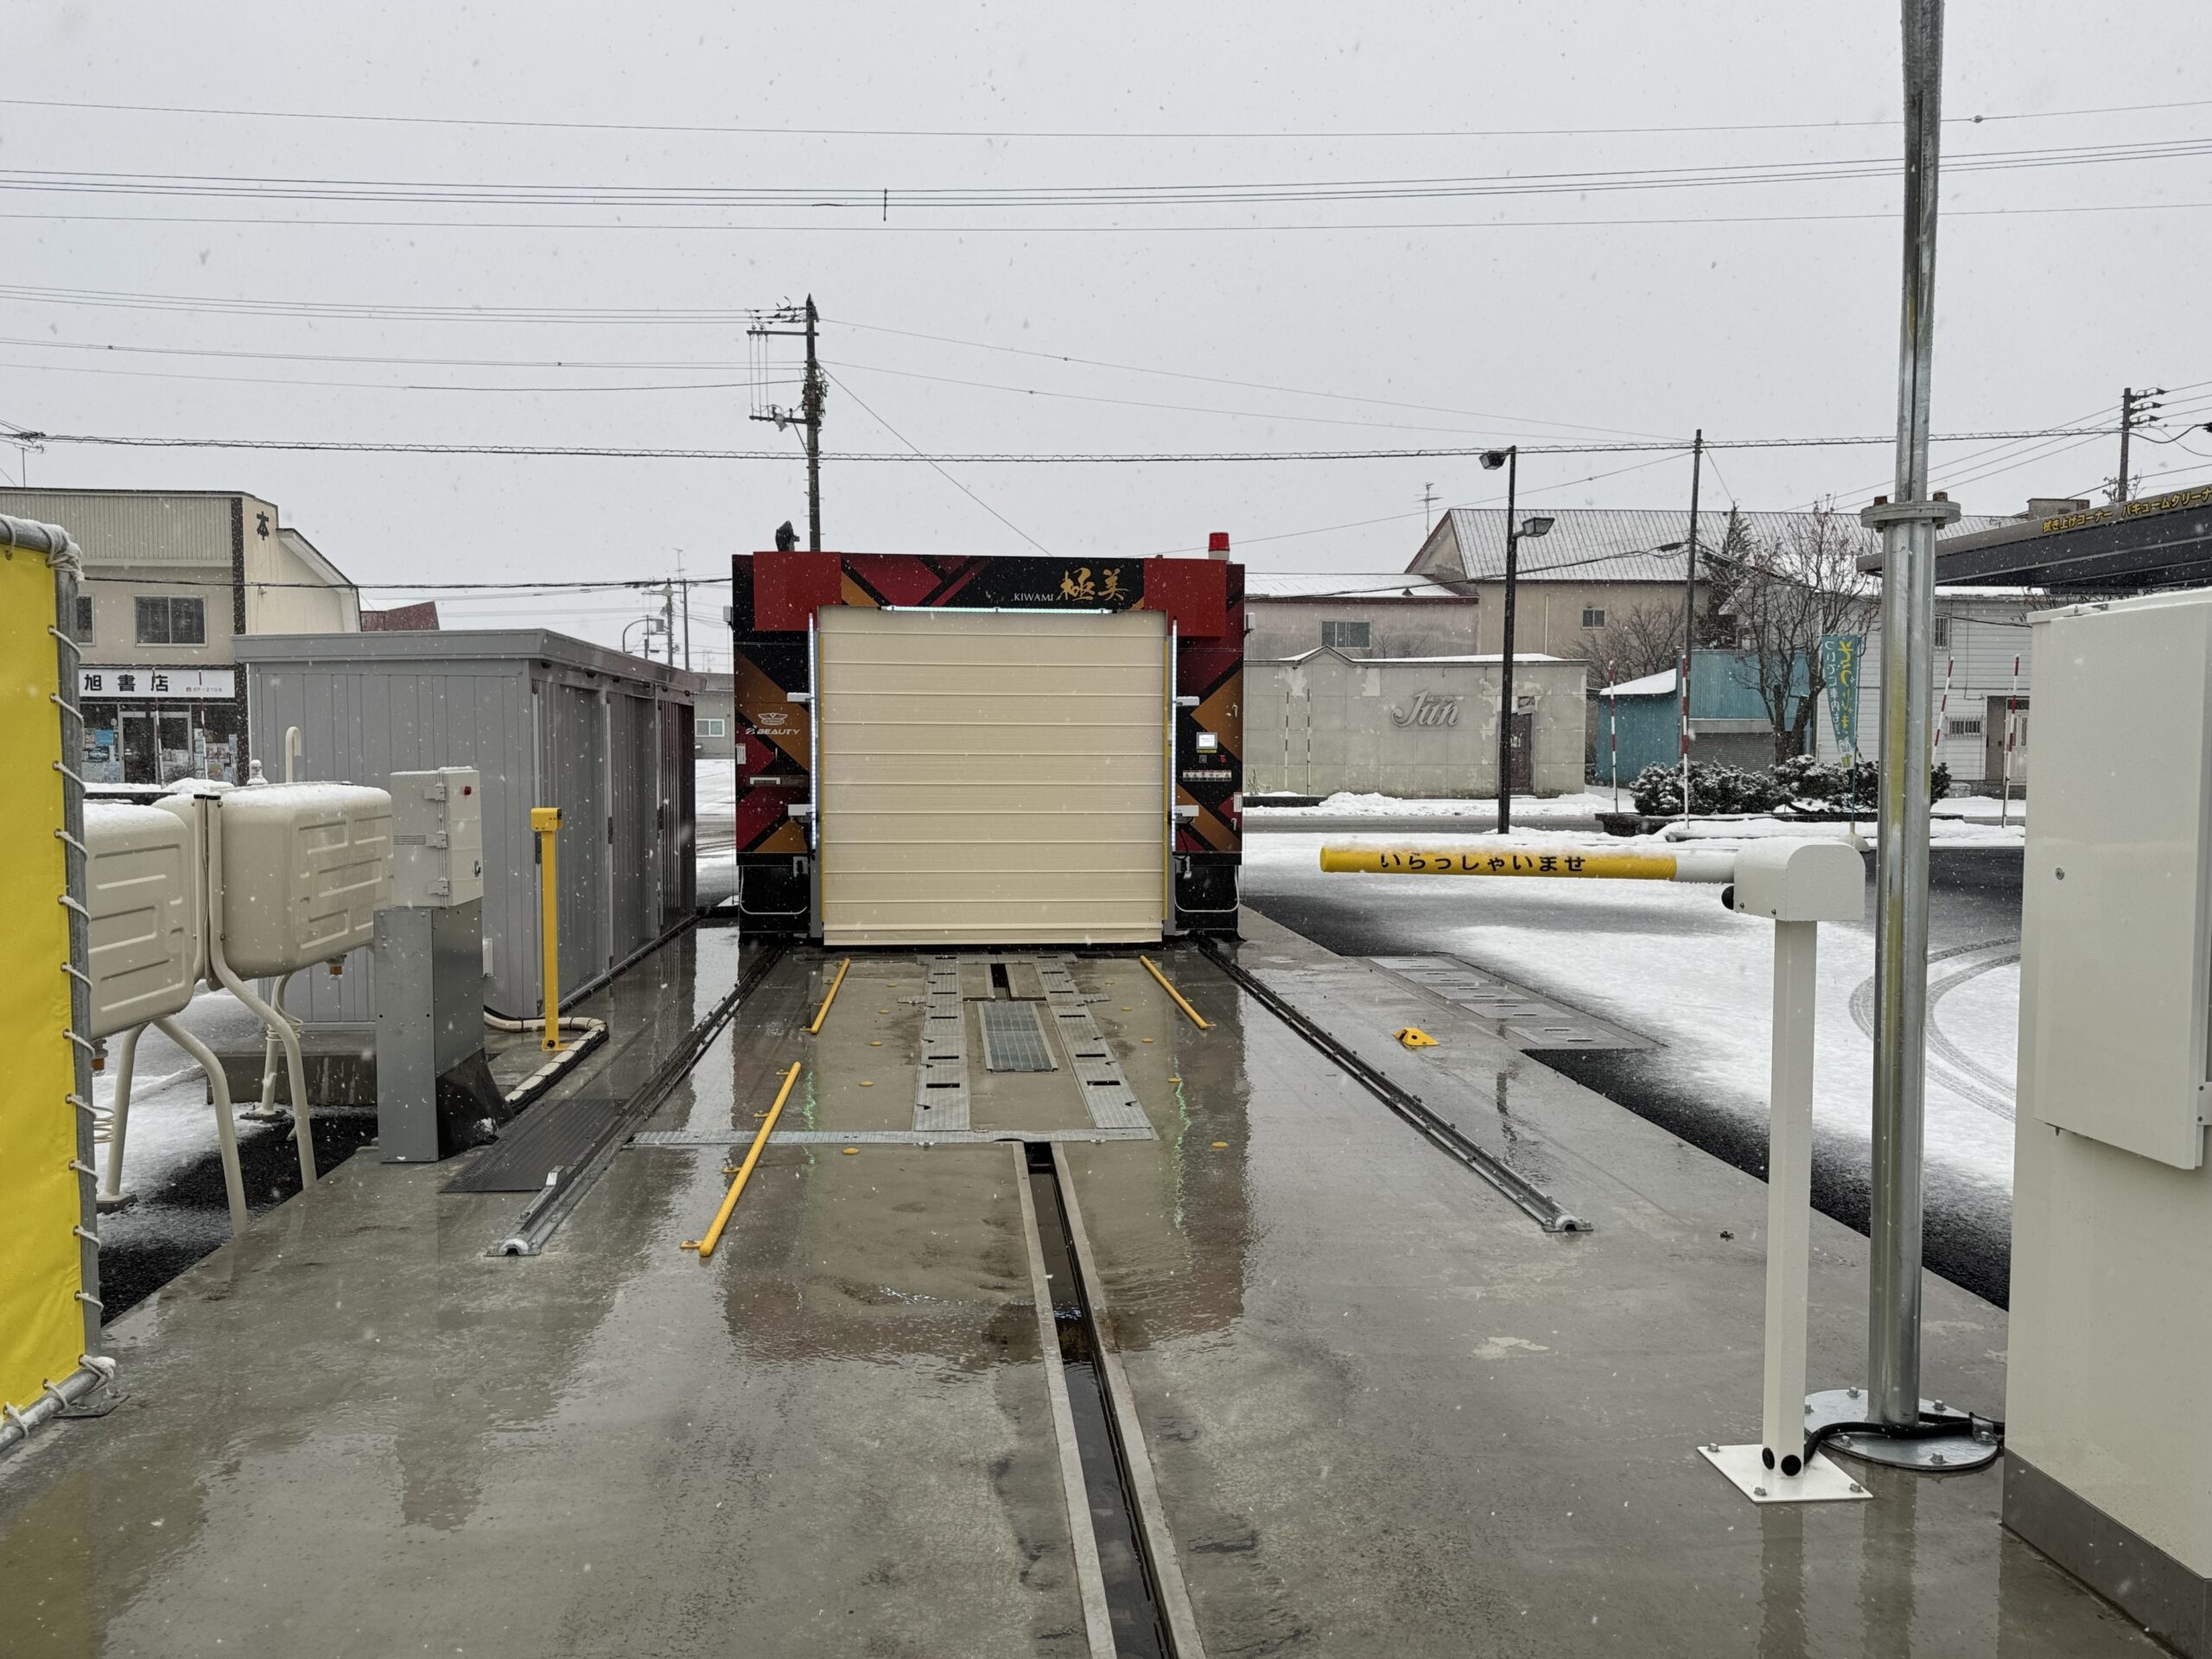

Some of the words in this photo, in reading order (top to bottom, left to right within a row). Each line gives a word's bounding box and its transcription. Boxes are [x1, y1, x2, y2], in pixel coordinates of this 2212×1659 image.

[256, 511, 270, 541] 本
[1056, 567, 1130, 602] 極美
[1014, 593, 1054, 602] KIWAMI
[84, 674, 168, 692] 旭書店
[1380, 852, 1586, 872] いらっしゃいませ
